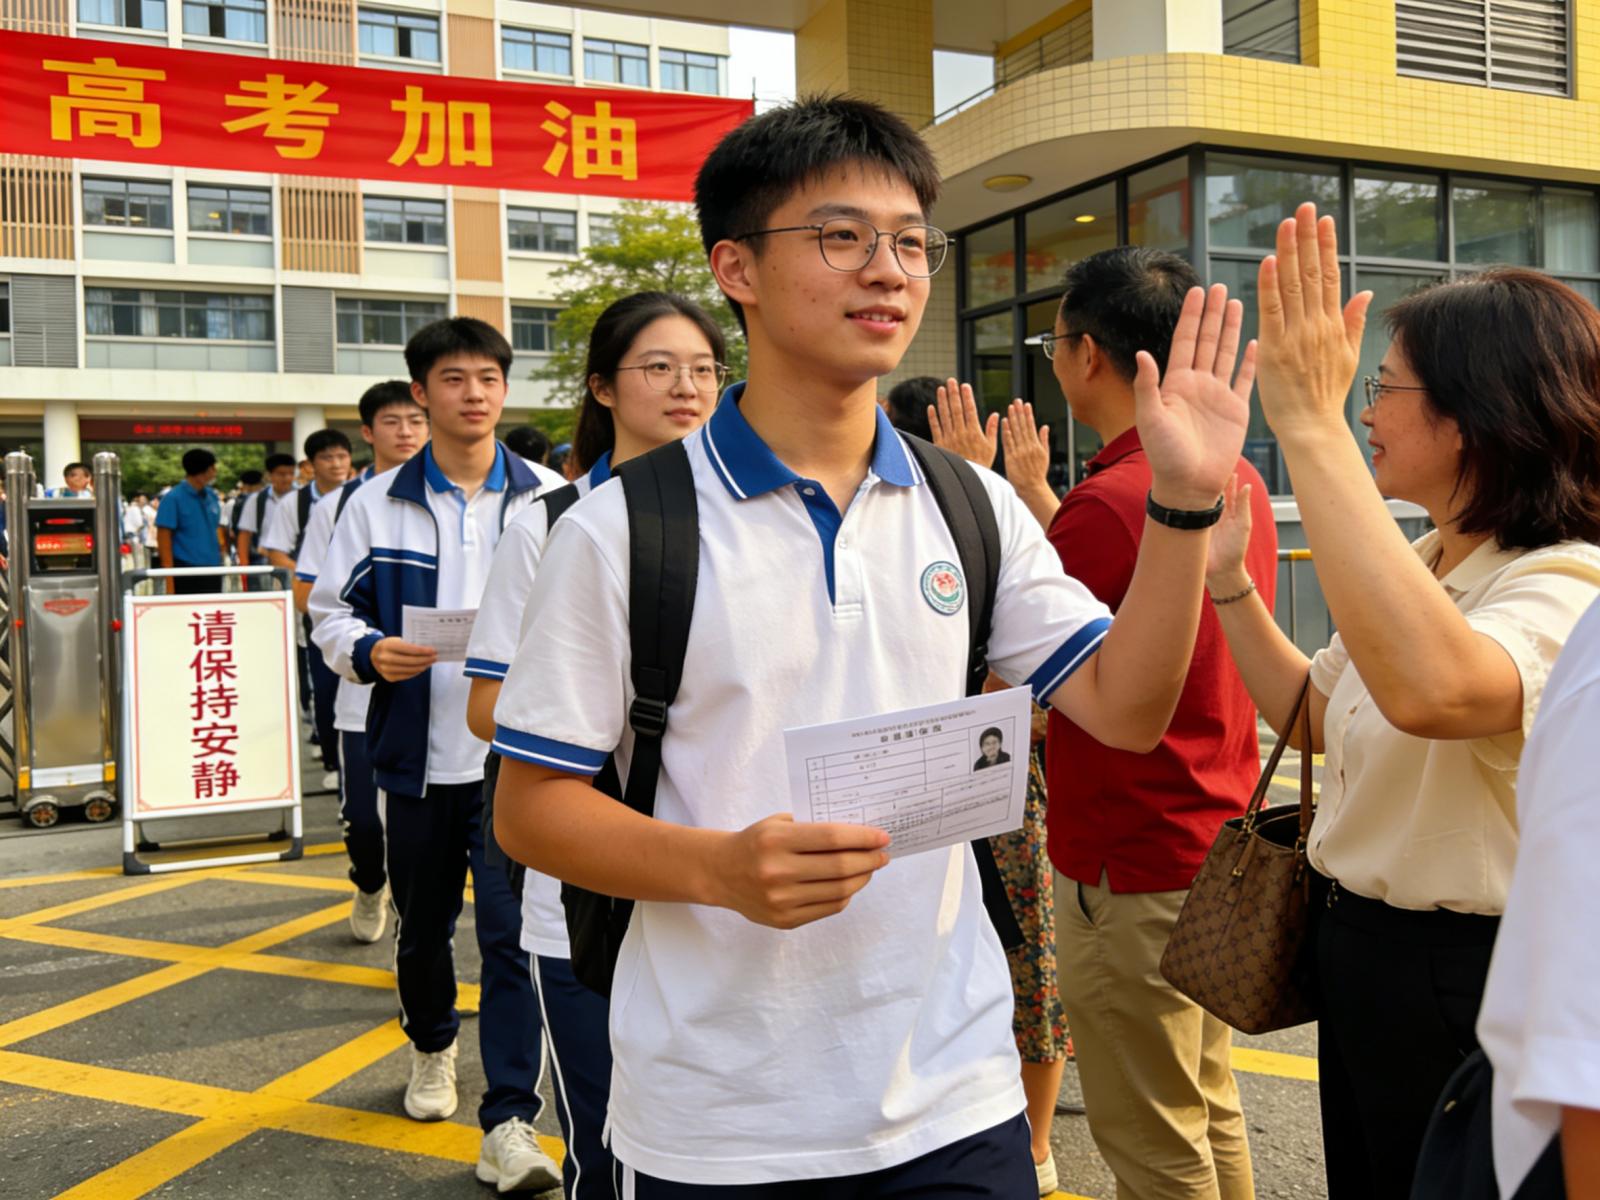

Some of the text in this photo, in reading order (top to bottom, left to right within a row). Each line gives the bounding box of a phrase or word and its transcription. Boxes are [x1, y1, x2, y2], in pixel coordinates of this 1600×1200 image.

[42, 58, 639, 181] 高考加油
[188, 610, 240, 799] 请保持安静
